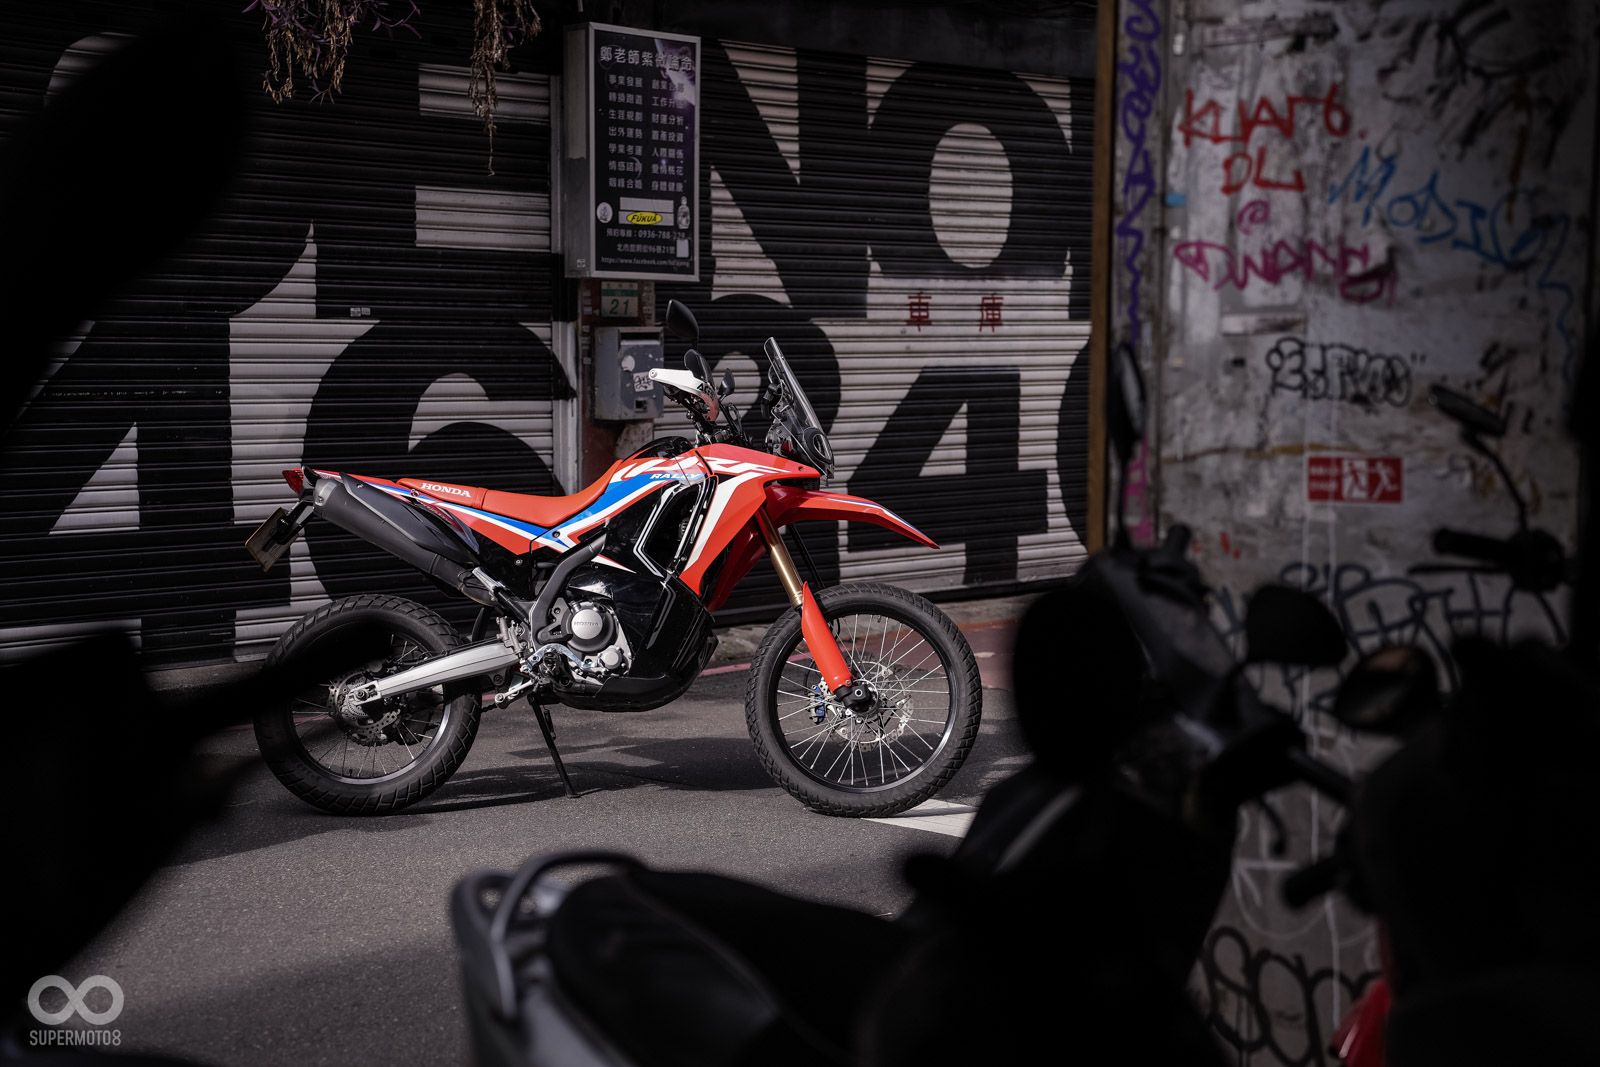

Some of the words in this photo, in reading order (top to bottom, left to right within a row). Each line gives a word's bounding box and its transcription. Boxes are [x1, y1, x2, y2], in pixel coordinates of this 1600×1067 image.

[599, 46, 693, 72] 鄭老師紫微論命
[608, 74, 643, 88] 事業發展
[608, 92, 643, 105] 轉換跑道
[608, 109, 643, 122] 生涯規劃
[651, 113, 684, 126] 財運分析
[608, 126, 643, 139] 出外運勢
[608, 143, 643, 156] 學業考運
[651, 147, 684, 159] 人際關係
[651, 164, 684, 176] 愛情桃花
[651, 181, 684, 193] 身體健康
[609, 298, 629, 316] 21
[906, 291, 1004, 332] 車庫
[649, 472, 700, 481] RALLY
[421, 482, 471, 498] HONDA
